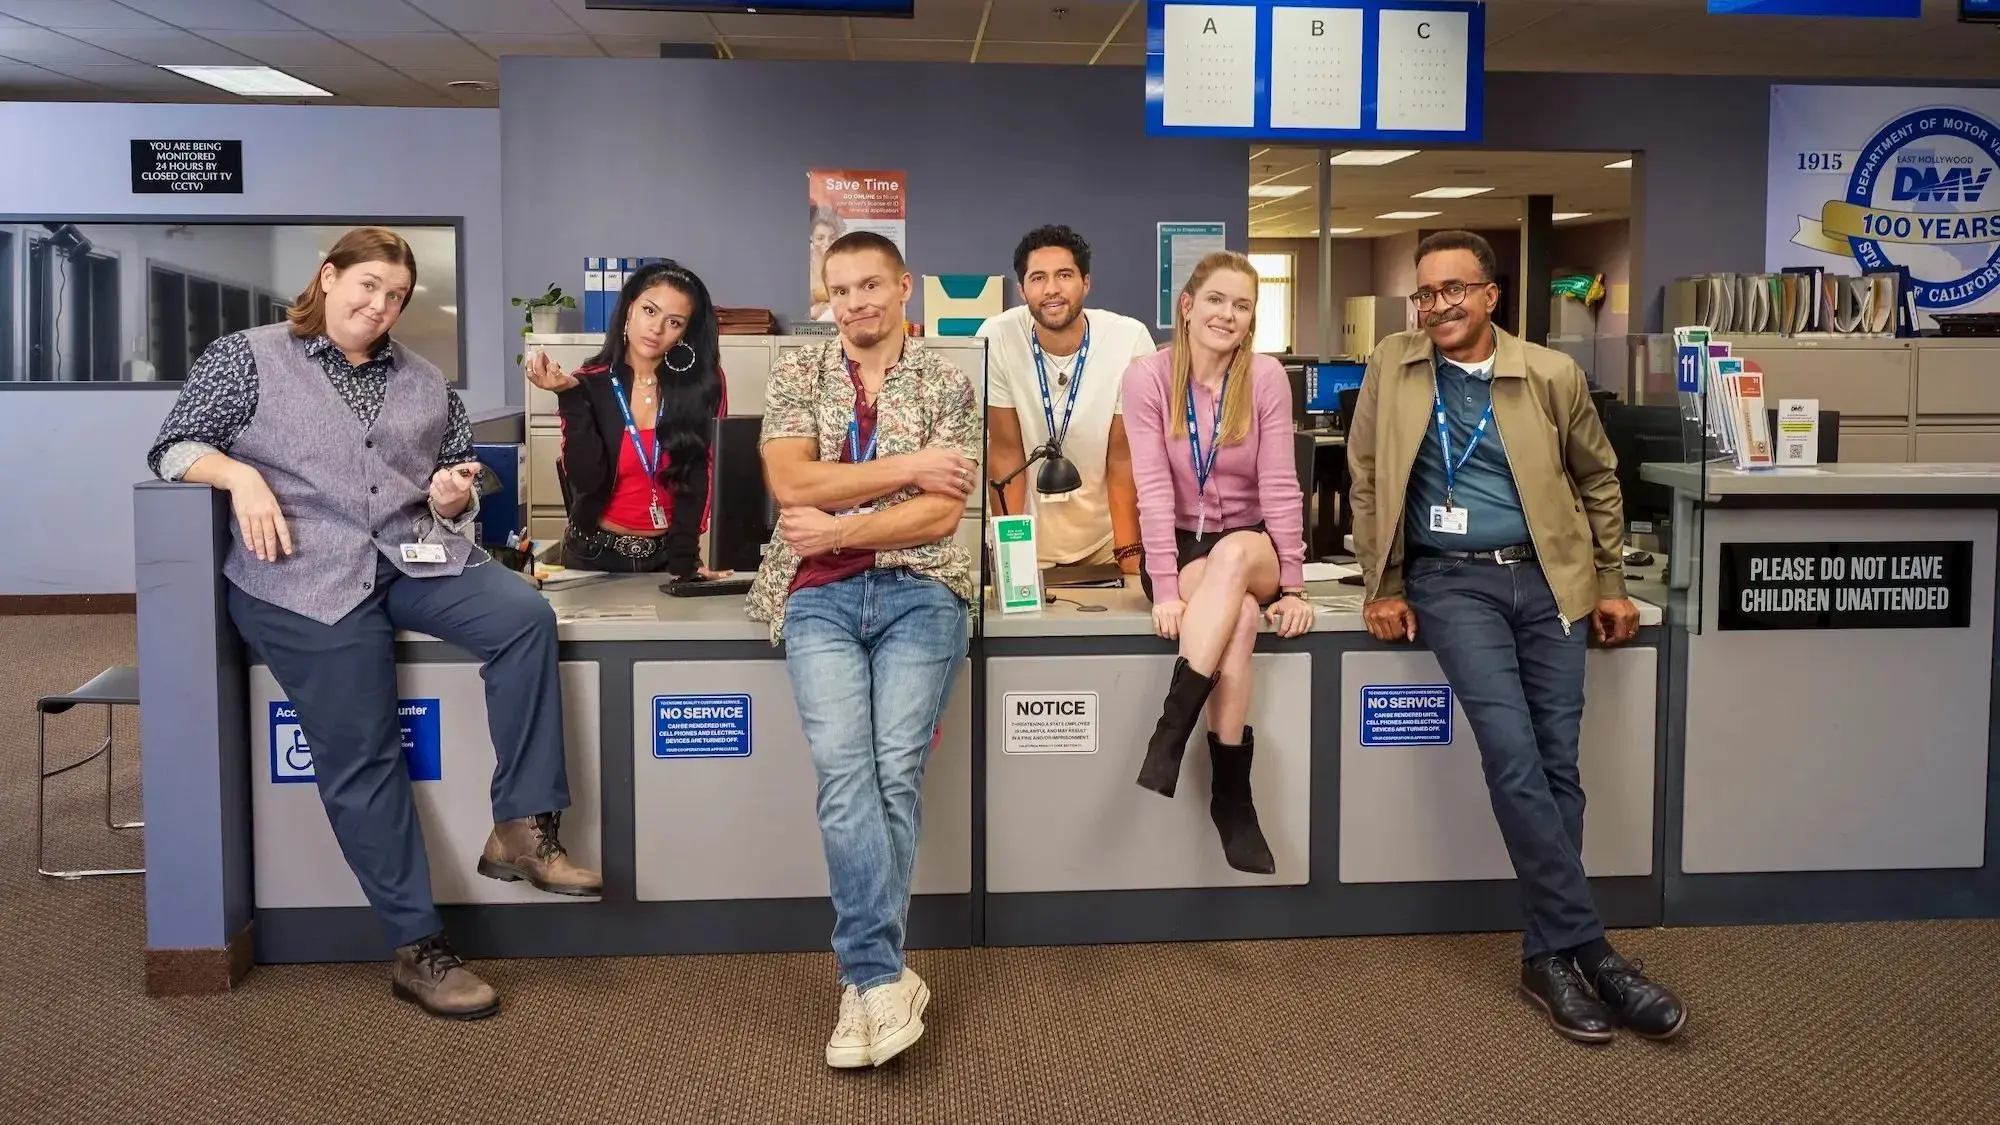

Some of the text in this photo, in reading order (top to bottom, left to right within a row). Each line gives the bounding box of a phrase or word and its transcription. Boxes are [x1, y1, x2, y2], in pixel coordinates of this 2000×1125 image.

[1203, 18, 1217, 34] A
[1312, 20, 1324, 36] B
[1418, 22, 1430, 38] C
[150, 142, 222, 151] YOU ARE BEING
[1798, 152, 1842, 170] 1915
[1856, 123, 1914, 196] DEPARTMENT
[1920, 118, 1937, 130] OF
[1943, 118, 1988, 141] MOTOR
[1897, 156, 1974, 164] EAST HOLLYWOOD
[171, 182, 203, 190] (CCTV)
[826, 178, 898, 191] Save Time
[1891, 168, 1992, 202] DMV
[1864, 214, 2000, 239] 100 YEARS
[1858, 242, 1884, 268] STA
[1912, 286, 1923, 298] F
[1682, 355, 1695, 383] 11
[1750, 556, 1943, 581] PLEASE DO NOT LEAVE
[1741, 587, 1949, 612] CHILDREN UNATTENDED
[1017, 701, 1086, 715] NOTICE
[1368, 697, 1445, 708] NO SERVICE
[398, 706, 427, 716] unter
[660, 707, 743, 719] NO SERVICE
